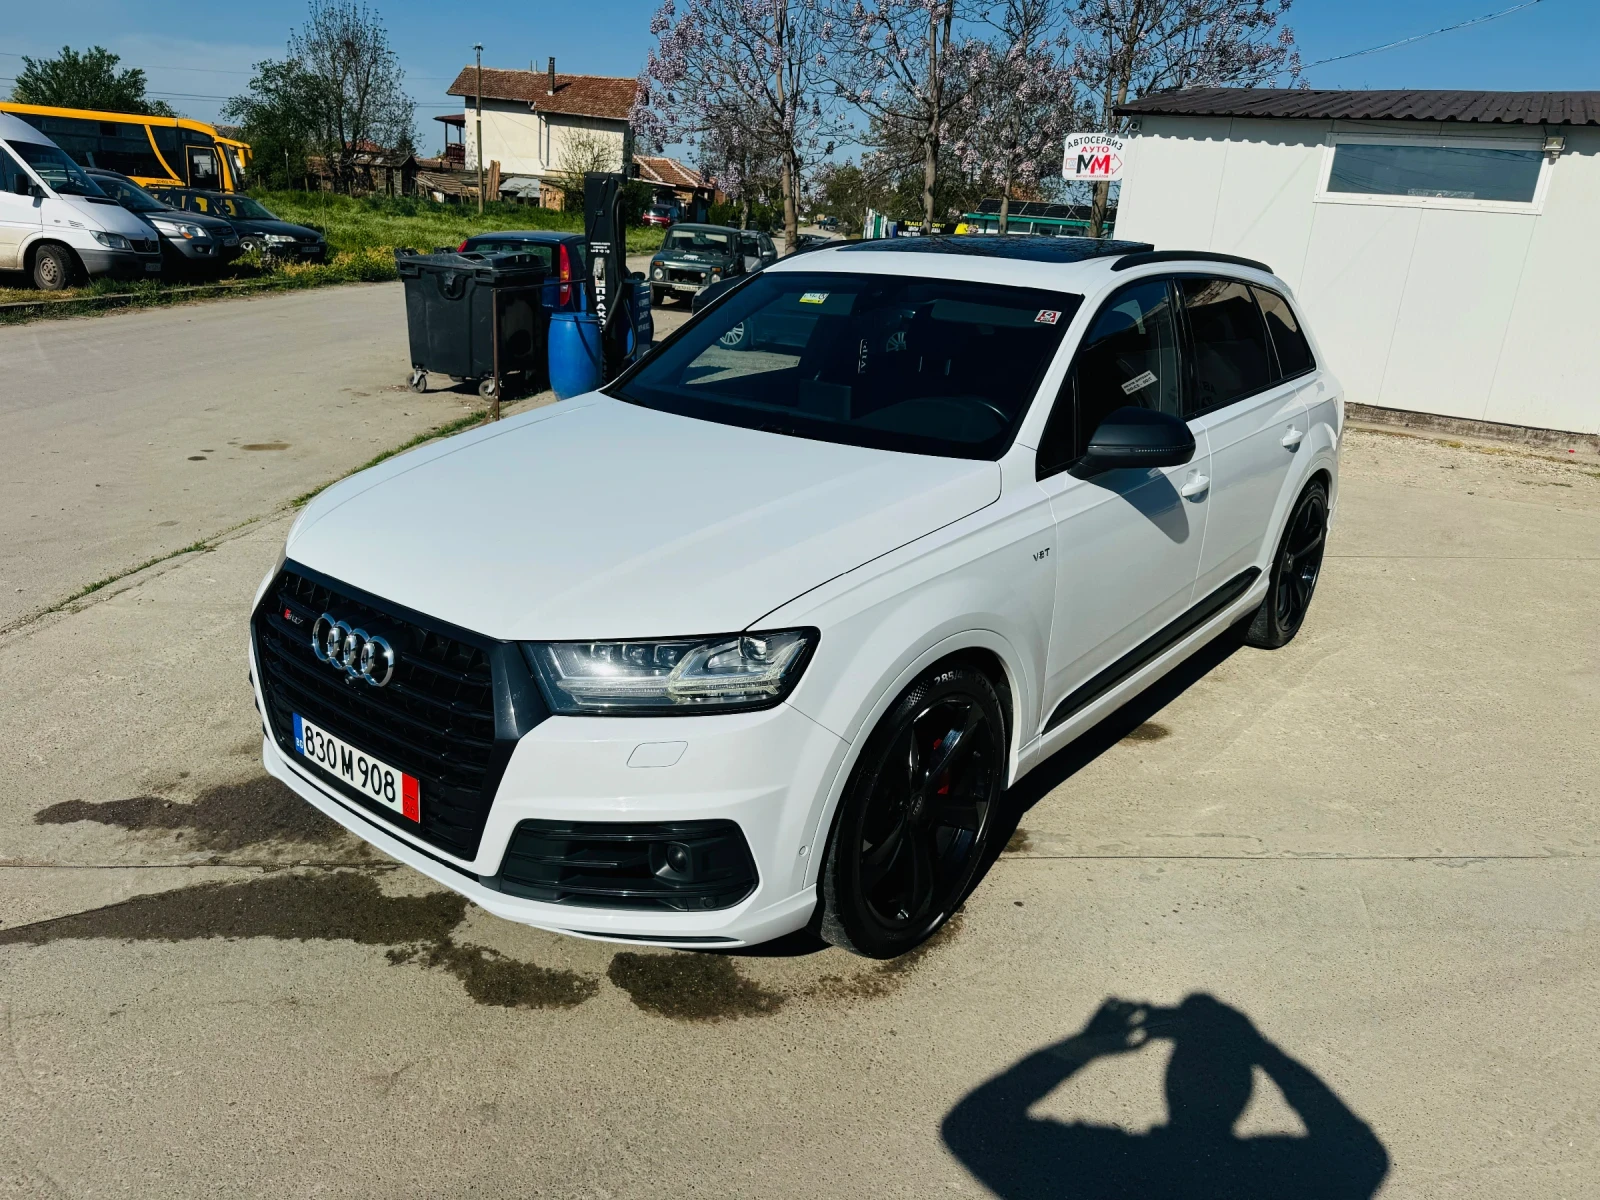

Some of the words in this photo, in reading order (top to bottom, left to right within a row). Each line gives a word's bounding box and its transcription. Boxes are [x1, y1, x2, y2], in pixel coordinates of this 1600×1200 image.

[1067, 136, 1123, 151] АВТОСЕРВИЗ
[296, 736, 304, 749] BG
[305, 725, 337, 769] 830
[340, 744, 354, 781] M
[357, 756, 396, 803] 908
[405, 801, 416, 815] 26
